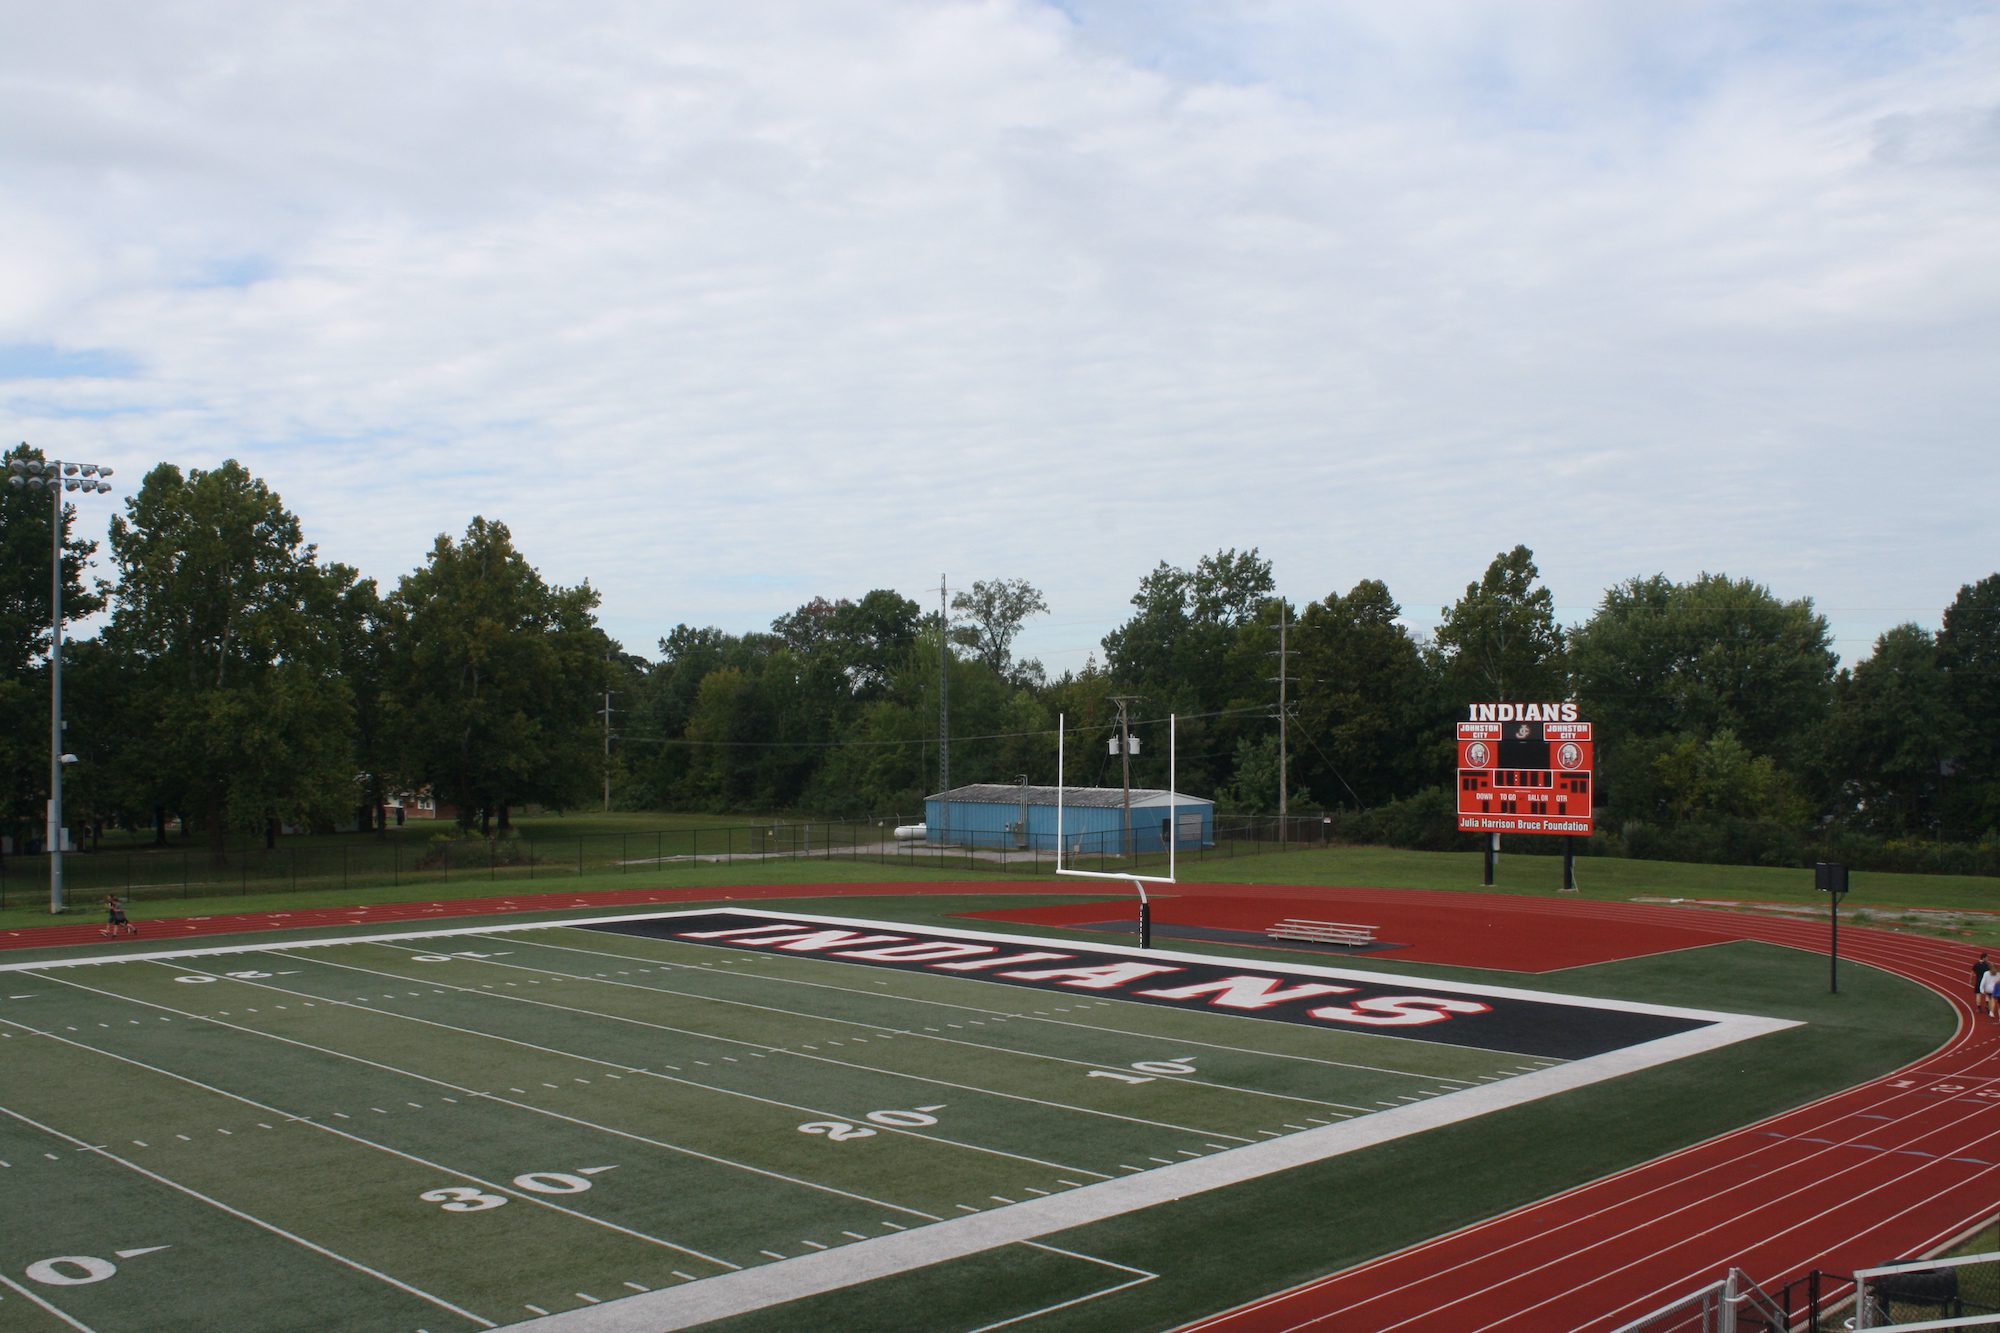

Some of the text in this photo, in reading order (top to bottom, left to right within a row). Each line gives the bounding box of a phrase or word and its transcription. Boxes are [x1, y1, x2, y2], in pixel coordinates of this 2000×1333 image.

[1469, 703, 1578, 721] INDIANS
[1460, 724, 1499, 732] JOHNSTON
[1547, 724, 1588, 732] JOHNSTON
[1460, 818, 1589, 831] Julia Harrison Bruce Foundation
[676, 923, 1491, 1027] INDIANS
[1086, 1061, 1197, 1085] 10
[797, 1109, 938, 1141] 20
[419, 1172, 592, 1212] 30
